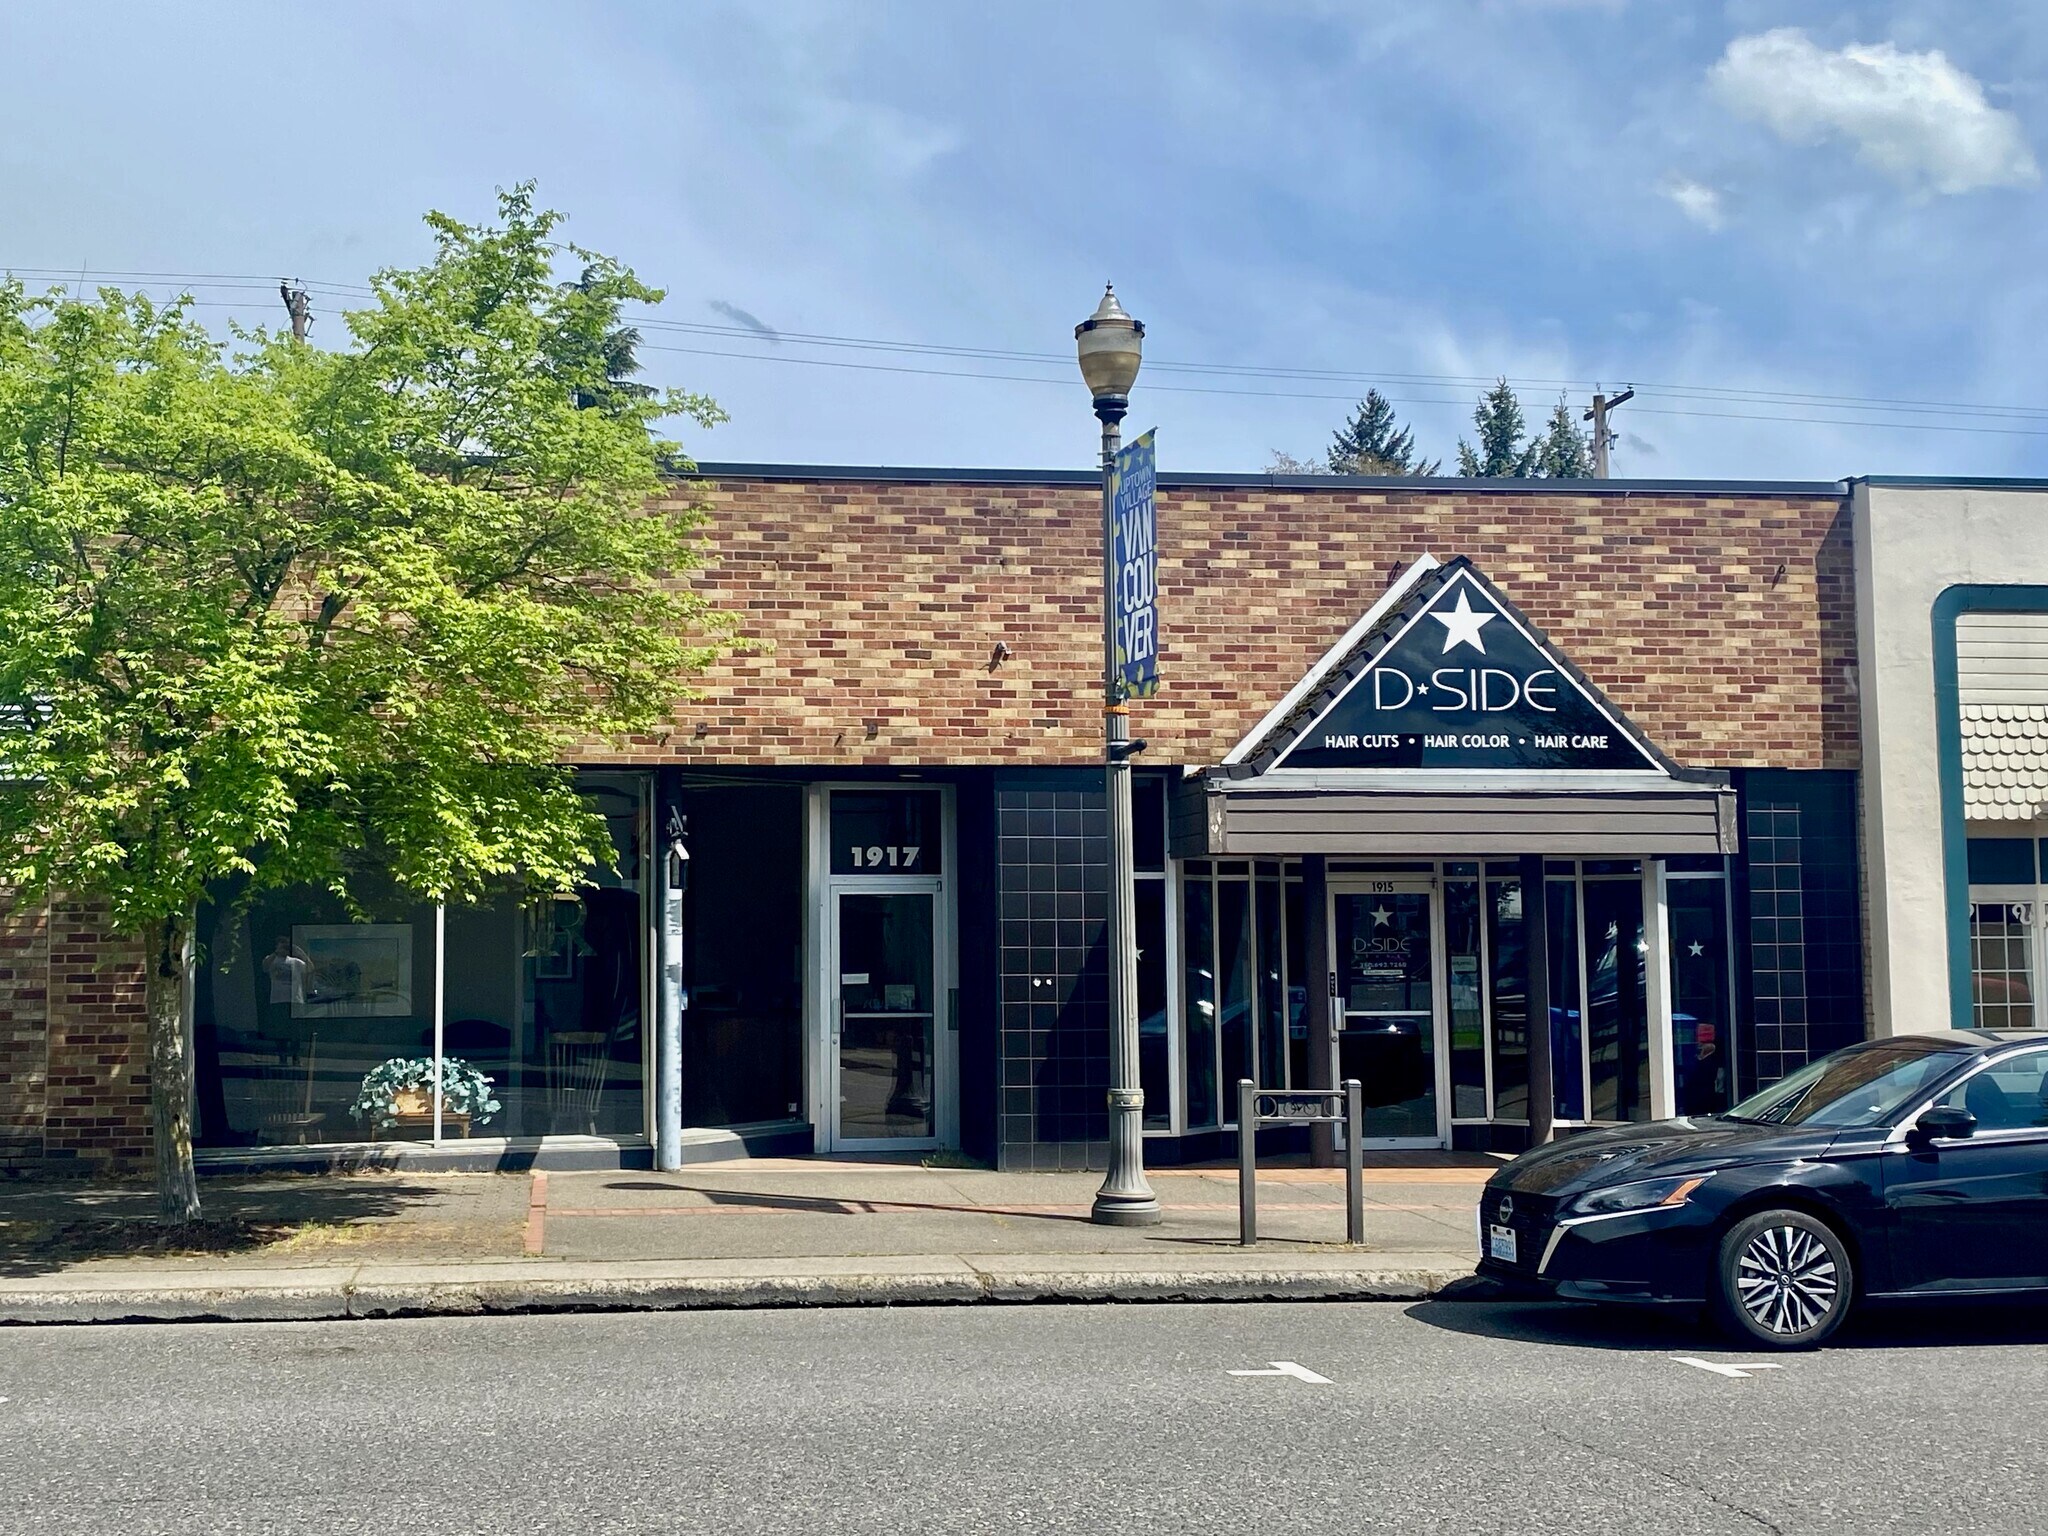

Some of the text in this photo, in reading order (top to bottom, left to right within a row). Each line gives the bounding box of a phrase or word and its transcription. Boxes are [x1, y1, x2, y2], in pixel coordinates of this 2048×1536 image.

[1120, 464, 1152, 495] UPTOWN
[1120, 480, 1152, 511] VILLAGE
[1121, 498, 1153, 562] VAN
[1122, 550, 1154, 614] COU
[1123, 606, 1154, 664] VER
[1325, 735, 1608, 748] HAIR CUTS HAIR COLOR HAIR CARE
[851, 846, 920, 867] 1917
[1371, 881, 1394, 893] 1915
